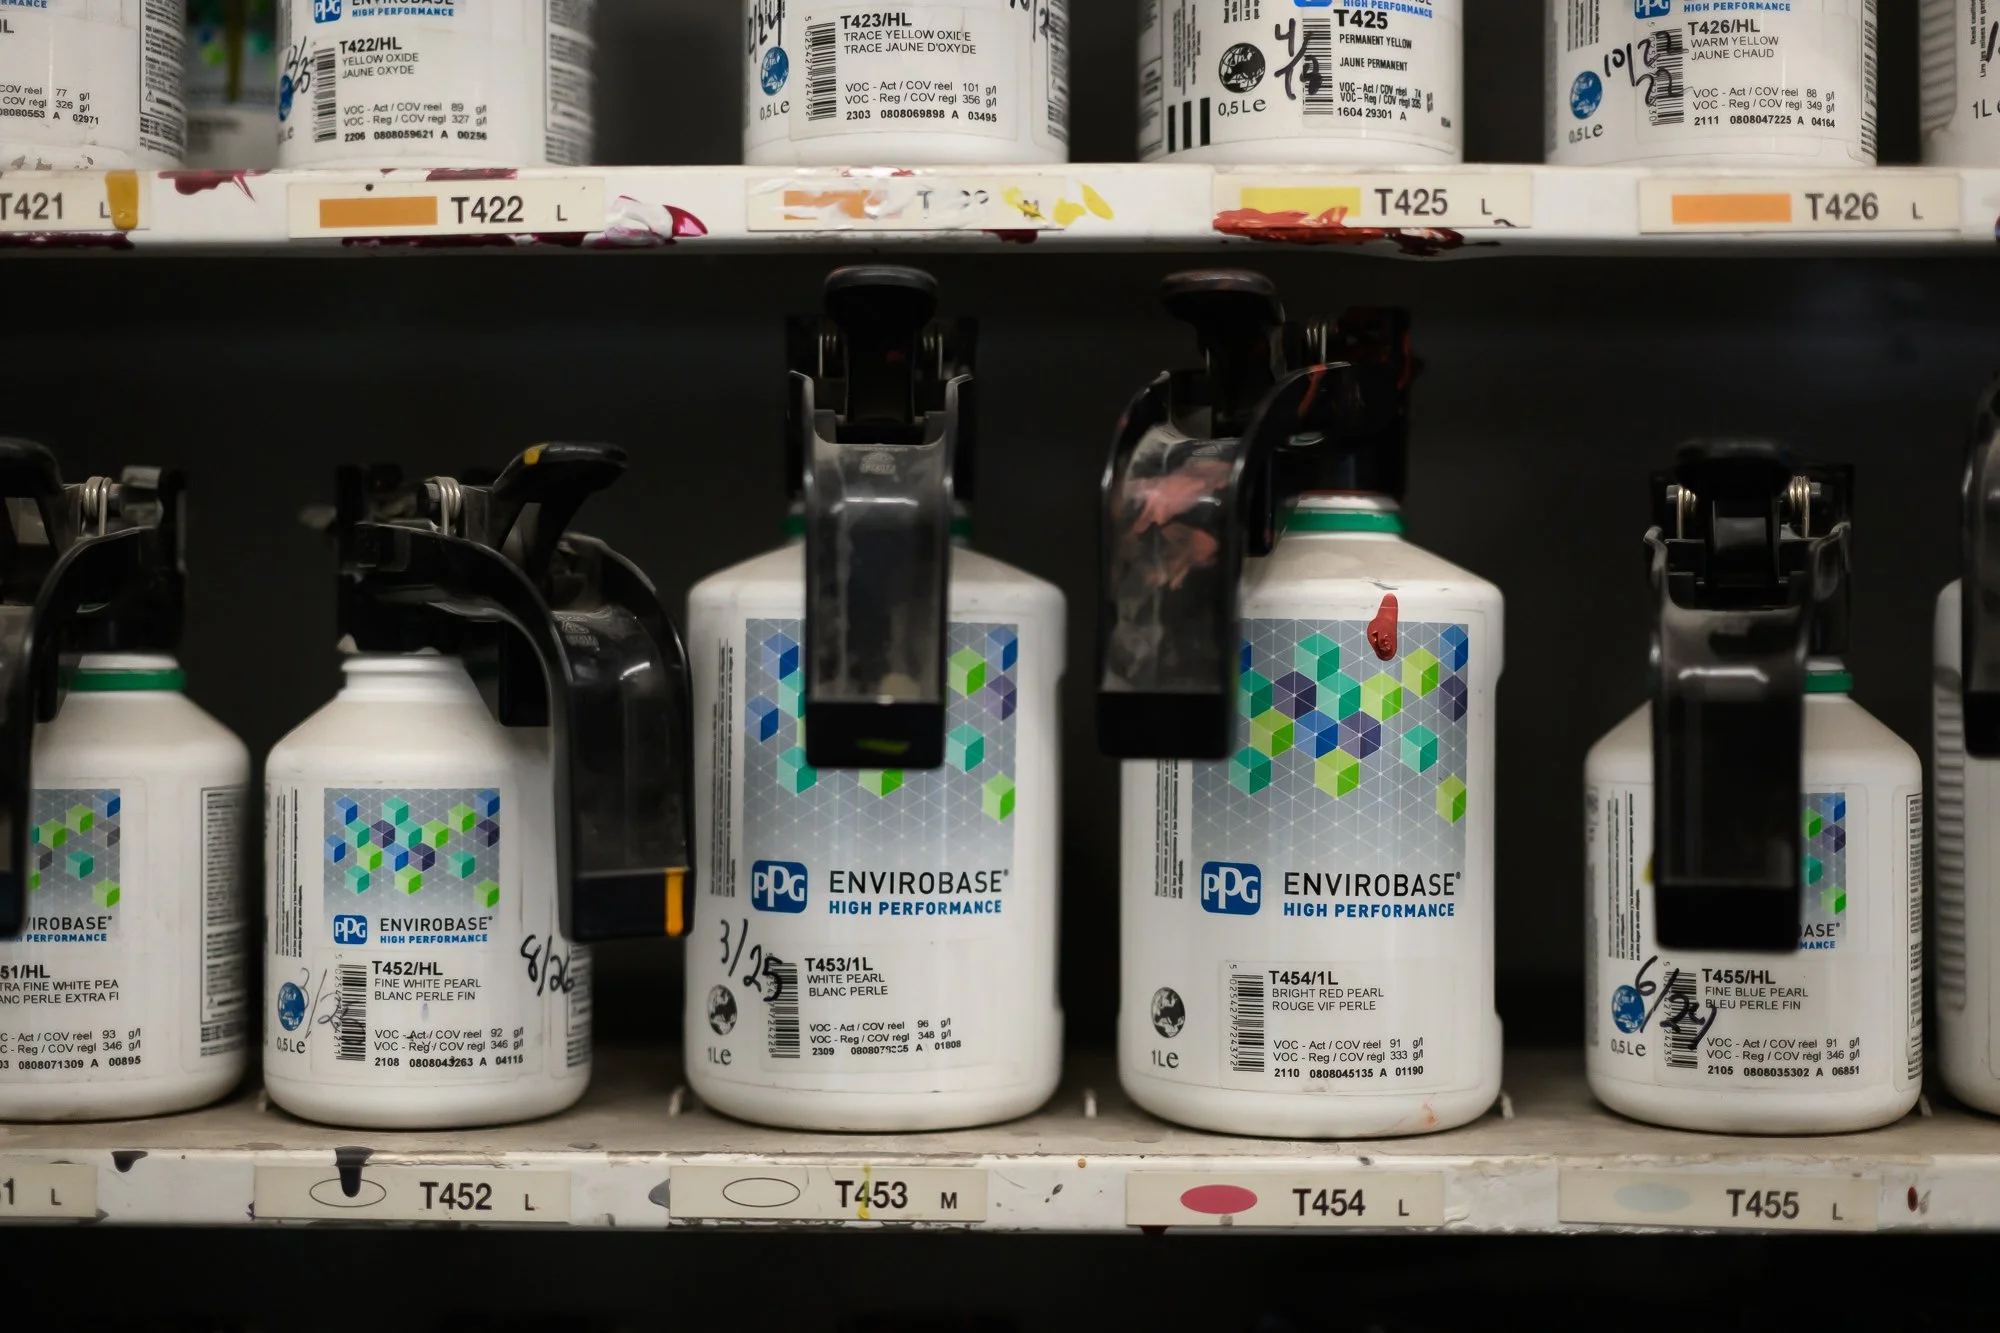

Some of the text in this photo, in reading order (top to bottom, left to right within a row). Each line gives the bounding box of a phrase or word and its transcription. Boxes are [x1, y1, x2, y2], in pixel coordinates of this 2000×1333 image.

[352, 7, 454, 17] HIGH PERFORMANCE
[1370, 1, 1433, 18] PERFORMANCE
[1683, 2, 1790, 13] HIGH PERFORMANCE
[840, 12, 912, 30] T423/HL
[1334, 9, 1388, 30] T425
[1687, 19, 1760, 37] T426/HL
[844, 32, 882, 43] TRACE
[885, 30, 934, 42] YELLOW
[1340, 34, 1412, 49] PERMANENT YELLOW
[1690, 35, 1779, 48] WARM YELLOW
[340, 37, 402, 54] T422/HL
[844, 42, 977, 55] TRACE JAUNE D'OXYDE
[342, 53, 419, 66] YELLOW OXIDE
[1691, 48, 1774, 61] JAUNE CHAUD
[1340, 57, 1408, 71] JAUNE PERMANENT
[342, 65, 414, 79] JAUNE OXYDE
[56, 88, 68, 97] 77
[845, 80, 979, 92] VOC Act COV 101
[56, 100, 73, 110] 326
[845, 92, 980, 104] VOC Reg COV 356
[53, 111, 99, 125] A 02971
[846, 109, 997, 122] 2303 0808069898 A 03495
[1337, 107, 1407, 121] 1604 29301 A
[1694, 115, 1835, 127] 2111 0808047225 A 04164
[440, 130, 448, 139] A
[0, 192, 63, 220] T421
[1374, 188, 1492, 216] T425 L
[1805, 192, 1924, 221] T426 L
[451, 195, 568, 225] T422 L
[753, 865, 805, 908] PPG
[1203, 866, 1258, 909] PPG
[829, 899, 1002, 916] HIGH PERFORMANCE
[1283, 902, 1455, 918] HIGH PERFORMANCE
[335, 917, 366, 943] PPG
[26, 933, 107, 943] PERFORMANCE
[380, 933, 488, 944] HIGH PERFORMANCE
[372, 961, 443, 976] T452/HL
[804, 956, 873, 973] T453/1L
[375, 978, 481, 989] FINE WHITE PEARL
[807, 973, 885, 985] WHITE PEARL
[1268, 970, 1338, 986] T454/1L
[1702, 968, 1776, 985] T455/HL
[23, 981, 49, 991] FINE
[52, 979, 91, 990] WHITE
[809, 985, 888, 997] BLANC PERLE
[23, 994, 61, 1004] PERLE
[65, 992, 106, 1003] EXTRA
[374, 991, 476, 1001] BLANC PERLE FIN
[1272, 988, 1384, 998] BRIGHT RED PEARL
[1705, 987, 1809, 998] FINE BLUE PEARL
[1272, 1001, 1376, 1011] ROUGE VIF PERLE
[1705, 999, 1801, 1010] BLEU PERLE FIN
[812, 1047, 835, 1056] 2309
[916, 1043, 923, 1052] A
[934, 1040, 962, 1050] 01808
[1273, 1040, 1298, 1050] VOC
[1308, 1040, 1326, 1049] Act
[1336, 1039, 1360, 1049] COV
[1389, 1038, 1401, 1048] 91
[18, 1056, 141, 1070] 0808071309 A 00895
[375, 1057, 399, 1067] 2108
[479, 1057, 487, 1066] A
[1273, 1052, 1298, 1062] VOC
[1308, 1052, 1330, 1064] Reg
[1339, 1051, 1363, 1061] COV
[1389, 1050, 1407, 1060] 333
[1274, 1066, 1424, 1078] 2110 0808045135 A 01190
[1707, 1065, 1860, 1077] 2105 0808035302 A 06851
[51, 1188, 61, 1205] L
[419, 1182, 536, 1211] T452 L
[834, 1180, 957, 1209] T453 M
[1292, 1188, 1409, 1217] T454 L
[1726, 1188, 1843, 1221] T455 L
